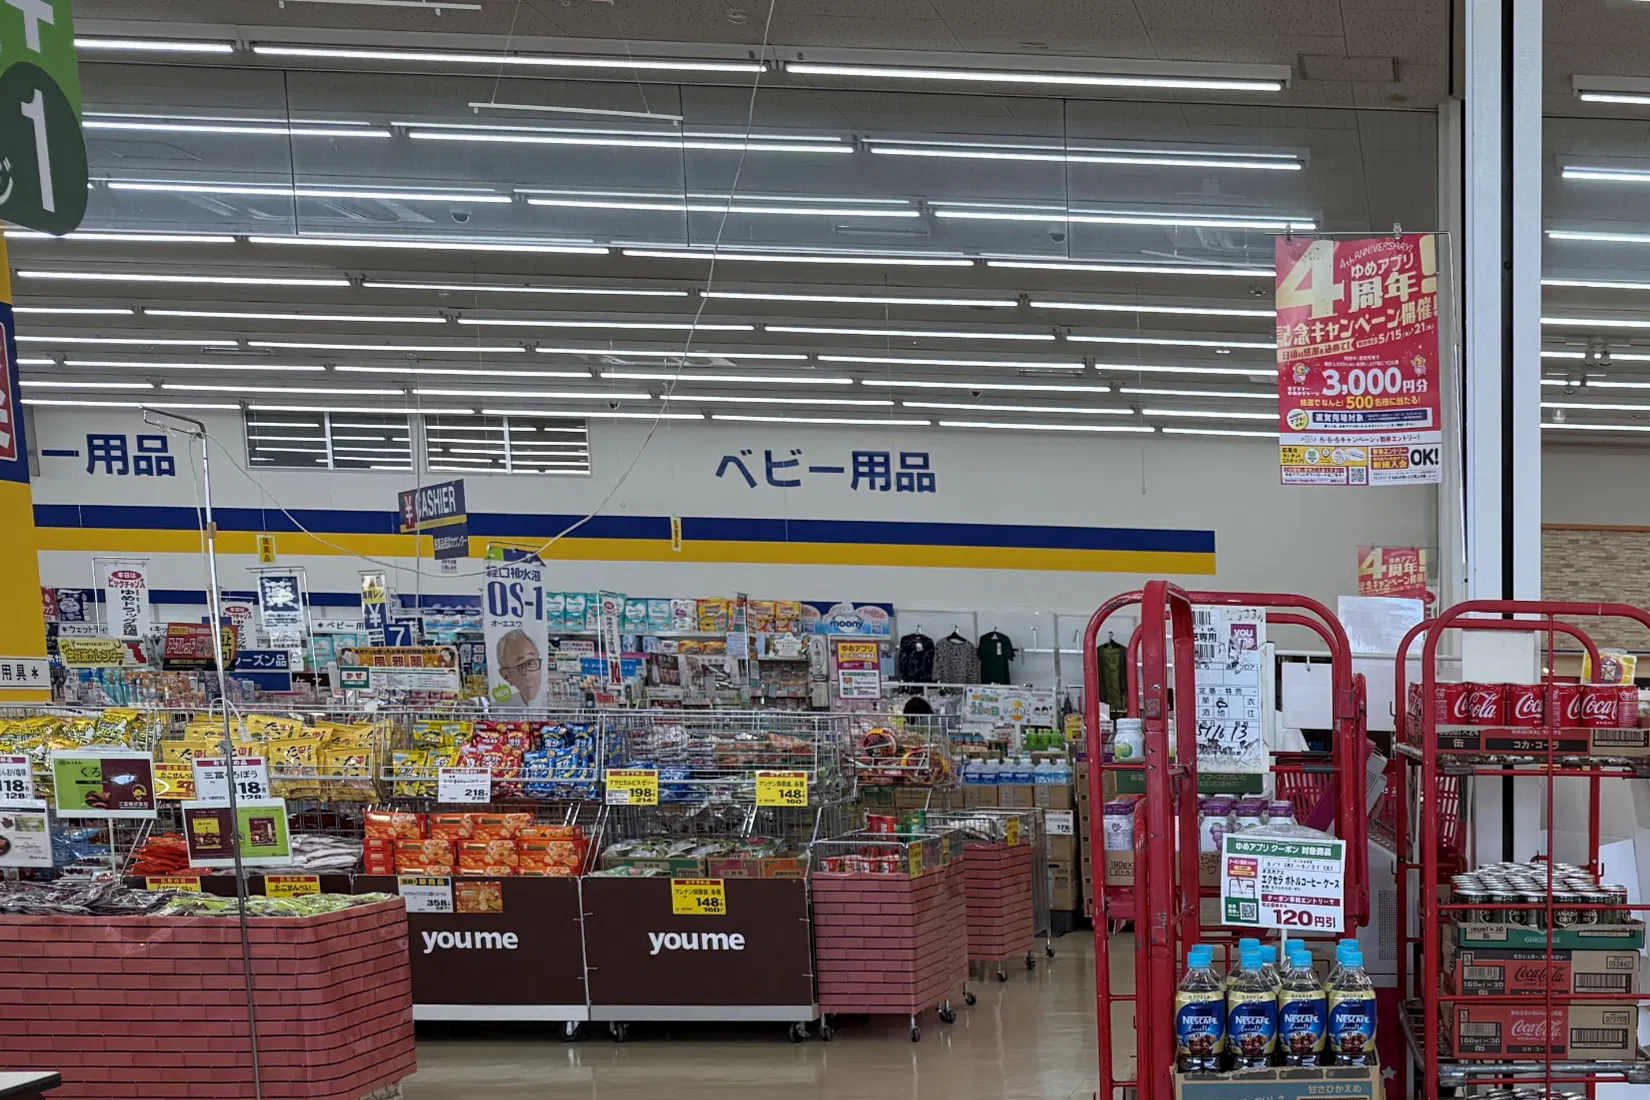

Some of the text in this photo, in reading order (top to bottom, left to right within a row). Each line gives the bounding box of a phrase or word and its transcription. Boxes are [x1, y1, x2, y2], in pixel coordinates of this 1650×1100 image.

[1351, 255, 1414, 277] ゆめアプリ
[1410, 448, 1438, 466] OK!
[716, 449, 937, 493] ベビー用品
[415, 486, 456, 518] CASHIER
[488, 581, 543, 620] OS-1
[830, 620, 863, 629] moony
[388, 628, 405, 646] 7
[629, 788, 652, 797] 198
[779, 790, 801, 798] 148
[1236, 843, 1331, 856] ゆめアプリ クーポン 対象商品
[1262, 875, 1283, 885] エクセラ
[1324, 880, 1339, 888] ケース
[696, 898, 719, 906] 148
[1308, 1085, 1361, 1093] 甘さひかえめ
